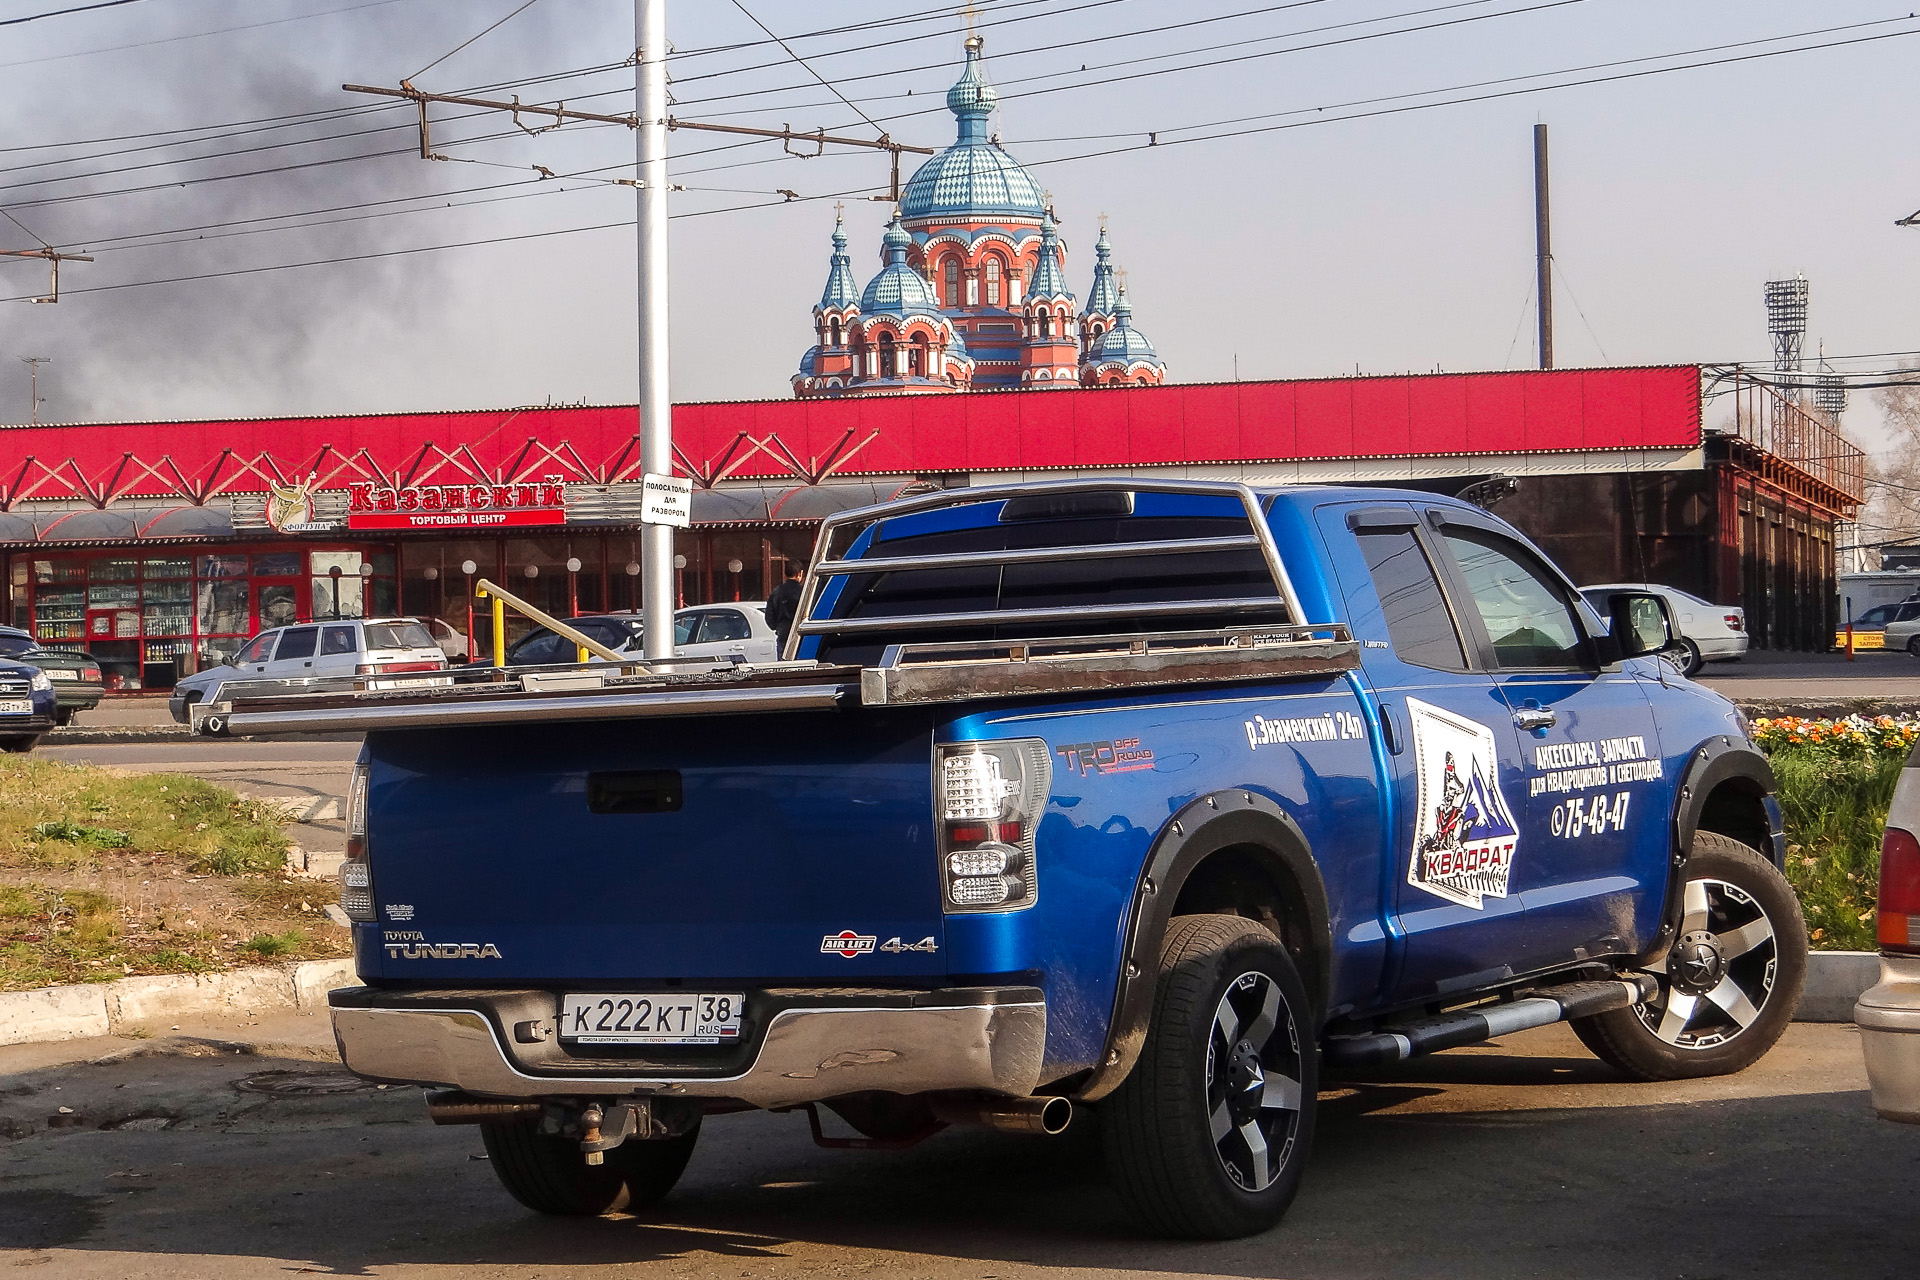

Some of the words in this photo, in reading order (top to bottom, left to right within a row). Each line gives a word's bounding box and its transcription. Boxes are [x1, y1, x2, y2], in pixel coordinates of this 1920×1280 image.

[348, 475, 566, 511] Казанский
[645, 482, 671, 492] ПОЛОСА
[663, 496, 677, 504] ДЛЯ
[409, 513, 468, 525] ТОРГОВЫЙ
[471, 513, 507, 525] ЦЕНТР
[651, 506, 686, 517] РАЗВОРОТА
[1244, 711, 1338, 751] р.Знаменский
[1336, 711, 1364, 740] 24п
[1055, 739, 1118, 778] TRD
[1114, 737, 1141, 749] OFF
[1117, 749, 1155, 763] ROAD
[1535, 741, 1601, 771] АКСЕССУАРЫ,
[1600, 735, 1646, 763] ЗАПЧАСТИ
[1546, 766, 1608, 794] КВАДРОЦИКЛОВ
[1617, 759, 1663, 783] СНЕГОХОДОВ
[1564, 791, 1631, 839] 75-43-47
[1427, 843, 1514, 877] КВАДРАТ
[383, 930, 425, 941] TOYOTA
[879, 935, 939, 953] 4x4
[384, 943, 503, 959] TUNDRA
[824, 940, 846, 949] AIR
[847, 940, 873, 949] LIFT
[701, 997, 731, 1023] 38
[699, 1025, 720, 1034] RUS
